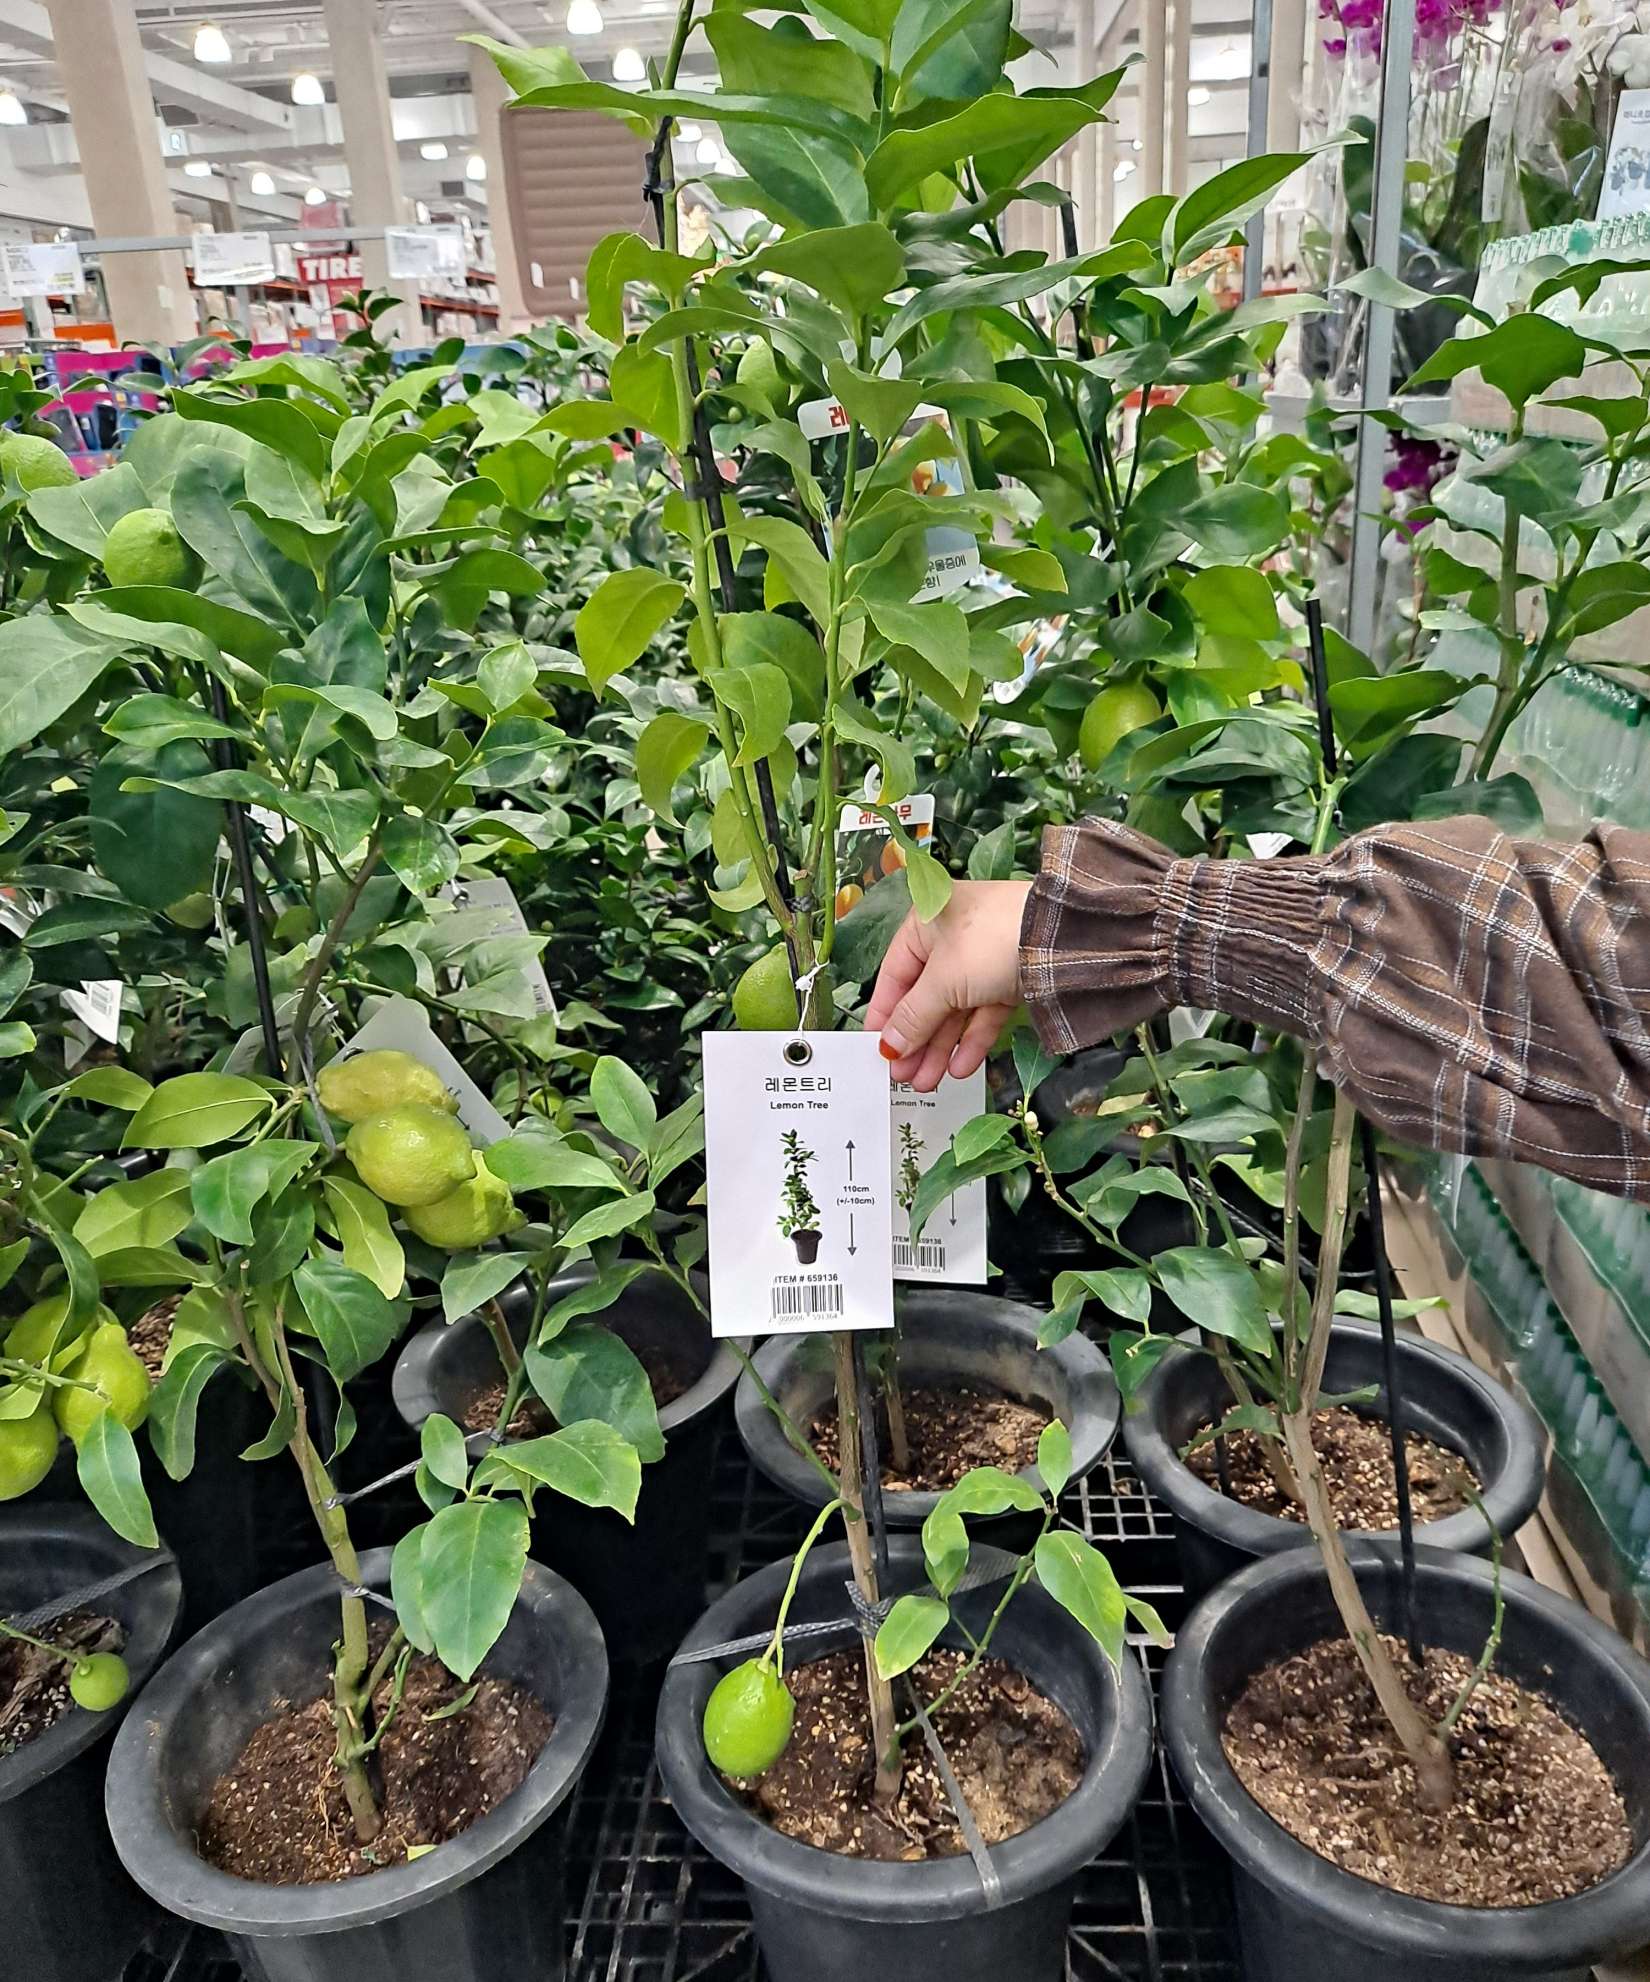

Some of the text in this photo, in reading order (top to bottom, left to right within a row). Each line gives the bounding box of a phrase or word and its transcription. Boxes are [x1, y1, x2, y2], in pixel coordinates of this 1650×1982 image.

[302, 257, 362, 281] TIRE
[765, 1077, 832, 1092] 레몬트리
[770, 1100, 829, 1110] Lemon Tree
[891, 1099, 917, 1107] Lemon
[843, 1185, 870, 1193] 110cm
[836, 1197, 875, 1206] (+/-10cm)
[774, 1273, 838, 1284] ITEM # 659136
